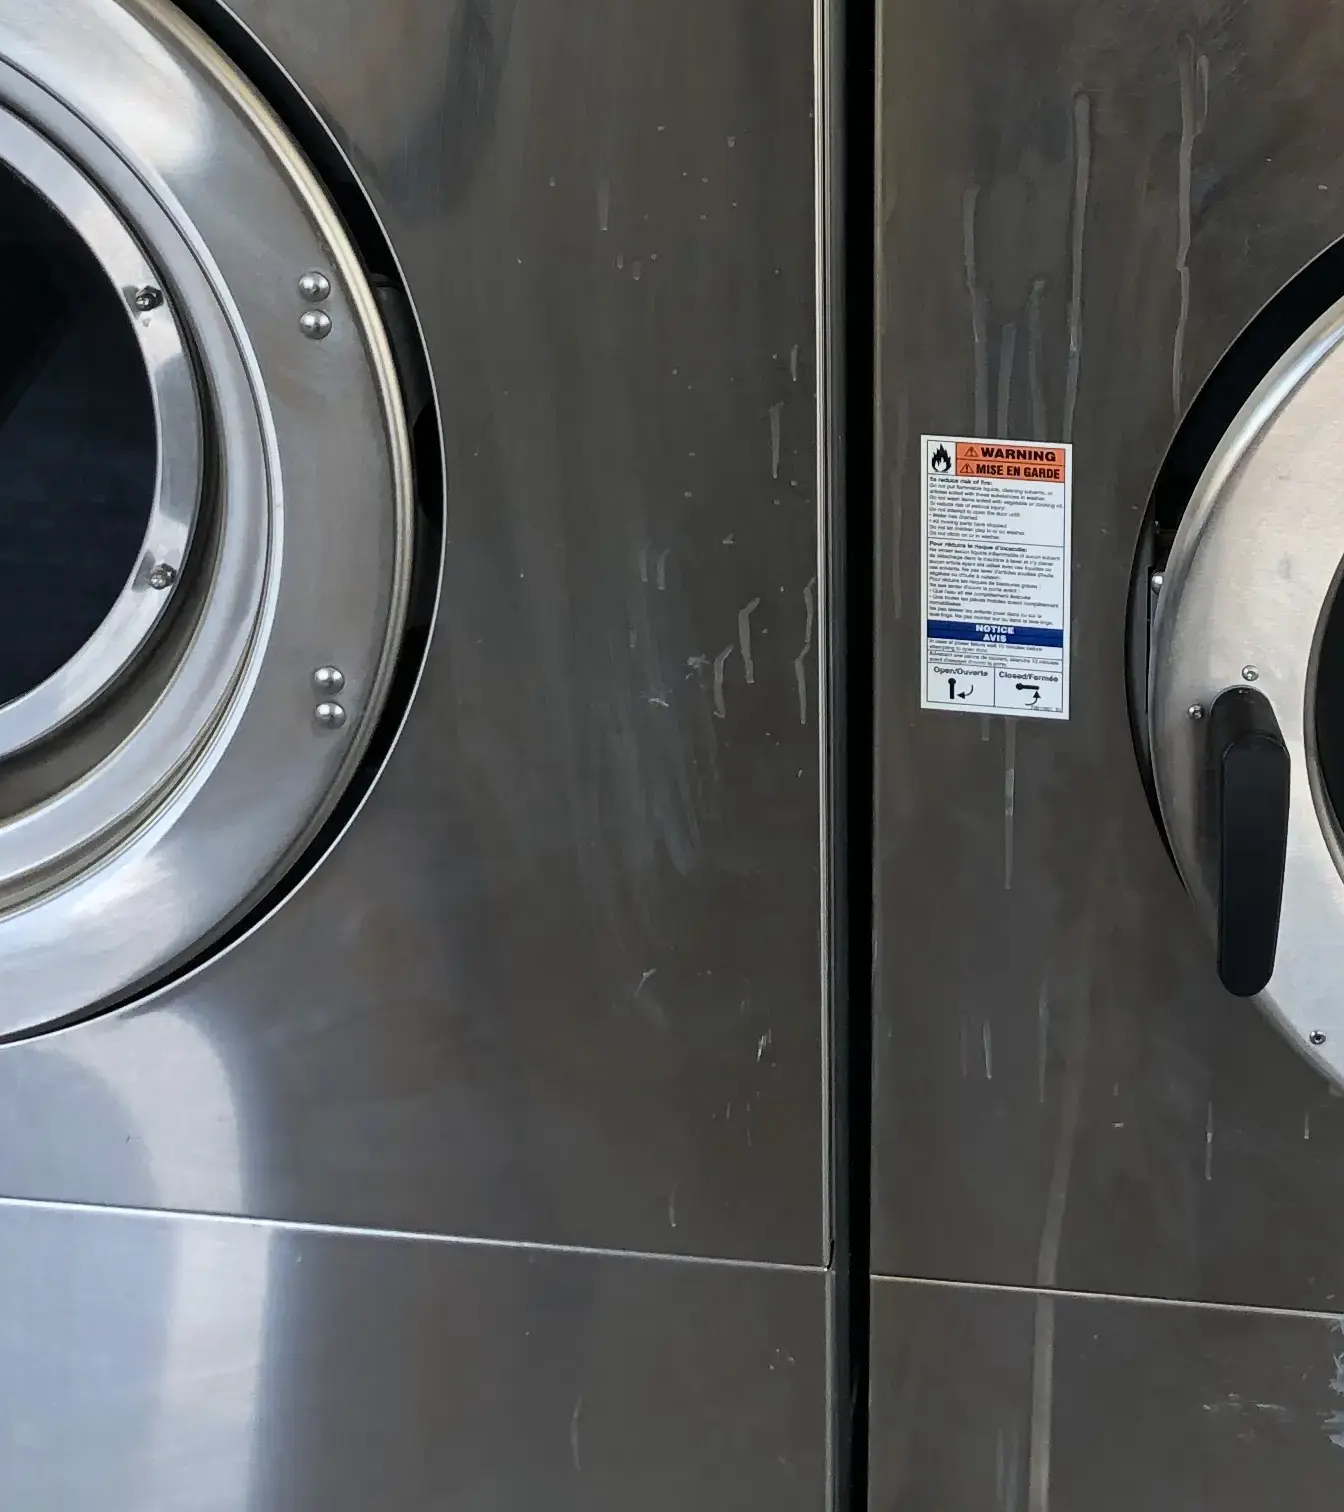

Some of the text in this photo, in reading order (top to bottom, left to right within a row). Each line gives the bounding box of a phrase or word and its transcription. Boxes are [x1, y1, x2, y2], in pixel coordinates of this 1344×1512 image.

[981, 447, 1056, 462] WARNING
[976, 464, 1060, 479] MISE EN GARDE
[976, 625, 1014, 634] NOTICE
[983, 634, 1006, 643] AVIS
[934, 667, 988, 677] Open/Ouverte
[999, 671, 1058, 682] Closed/Fermée
